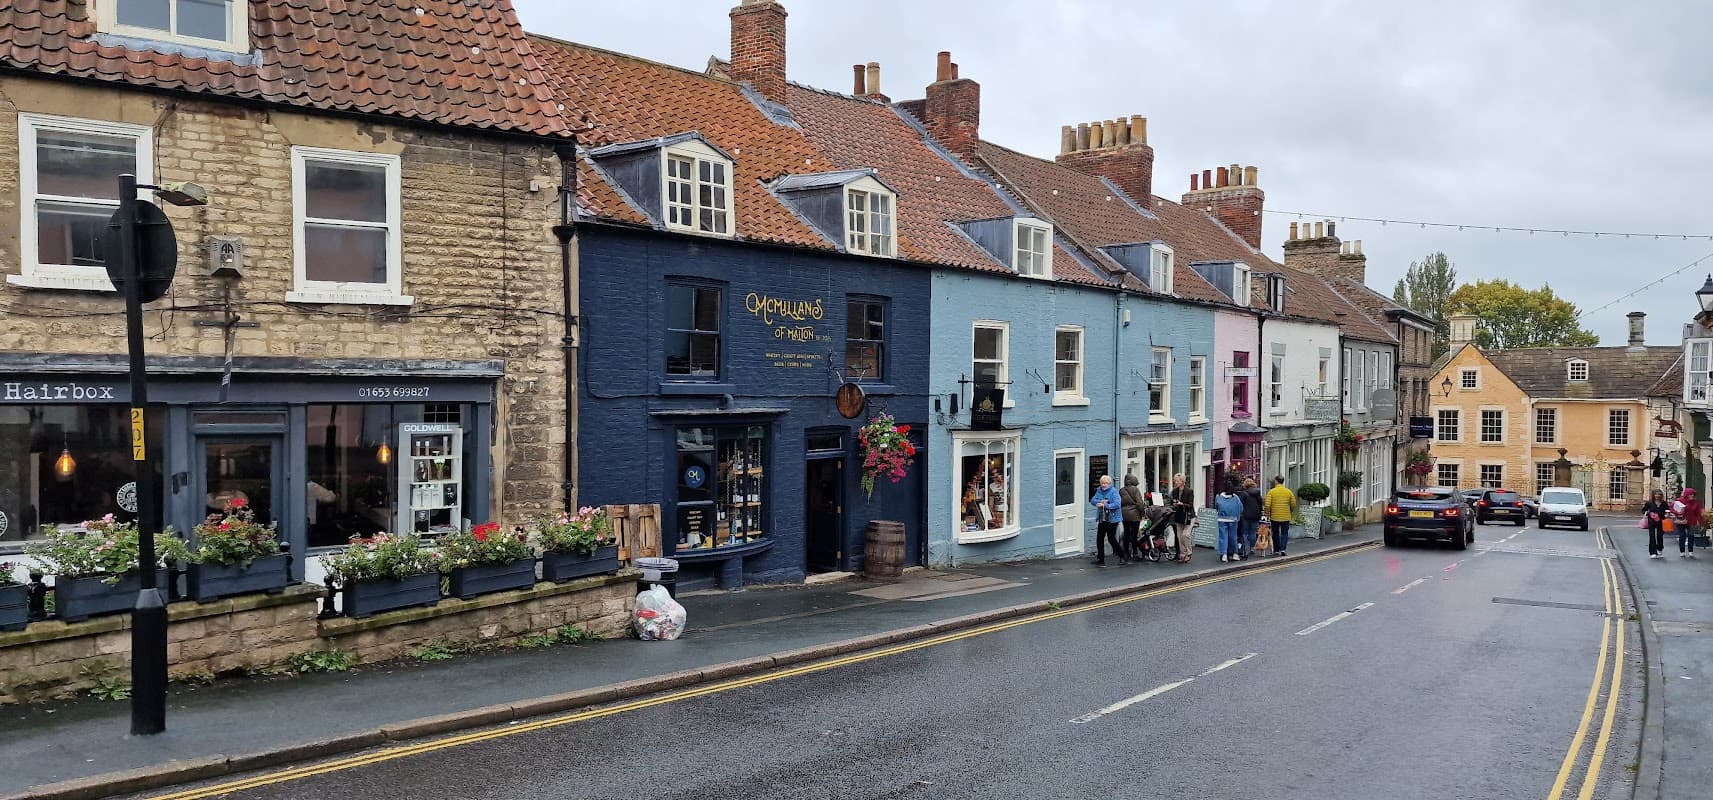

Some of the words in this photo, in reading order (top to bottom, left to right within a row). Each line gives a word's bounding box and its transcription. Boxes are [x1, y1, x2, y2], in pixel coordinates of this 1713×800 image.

[4, 382, 114, 400] Hairbox
[358, 387, 391, 398] 01653
[393, 386, 430, 398] 699827
[404, 424, 452, 432] GOLDWELL
